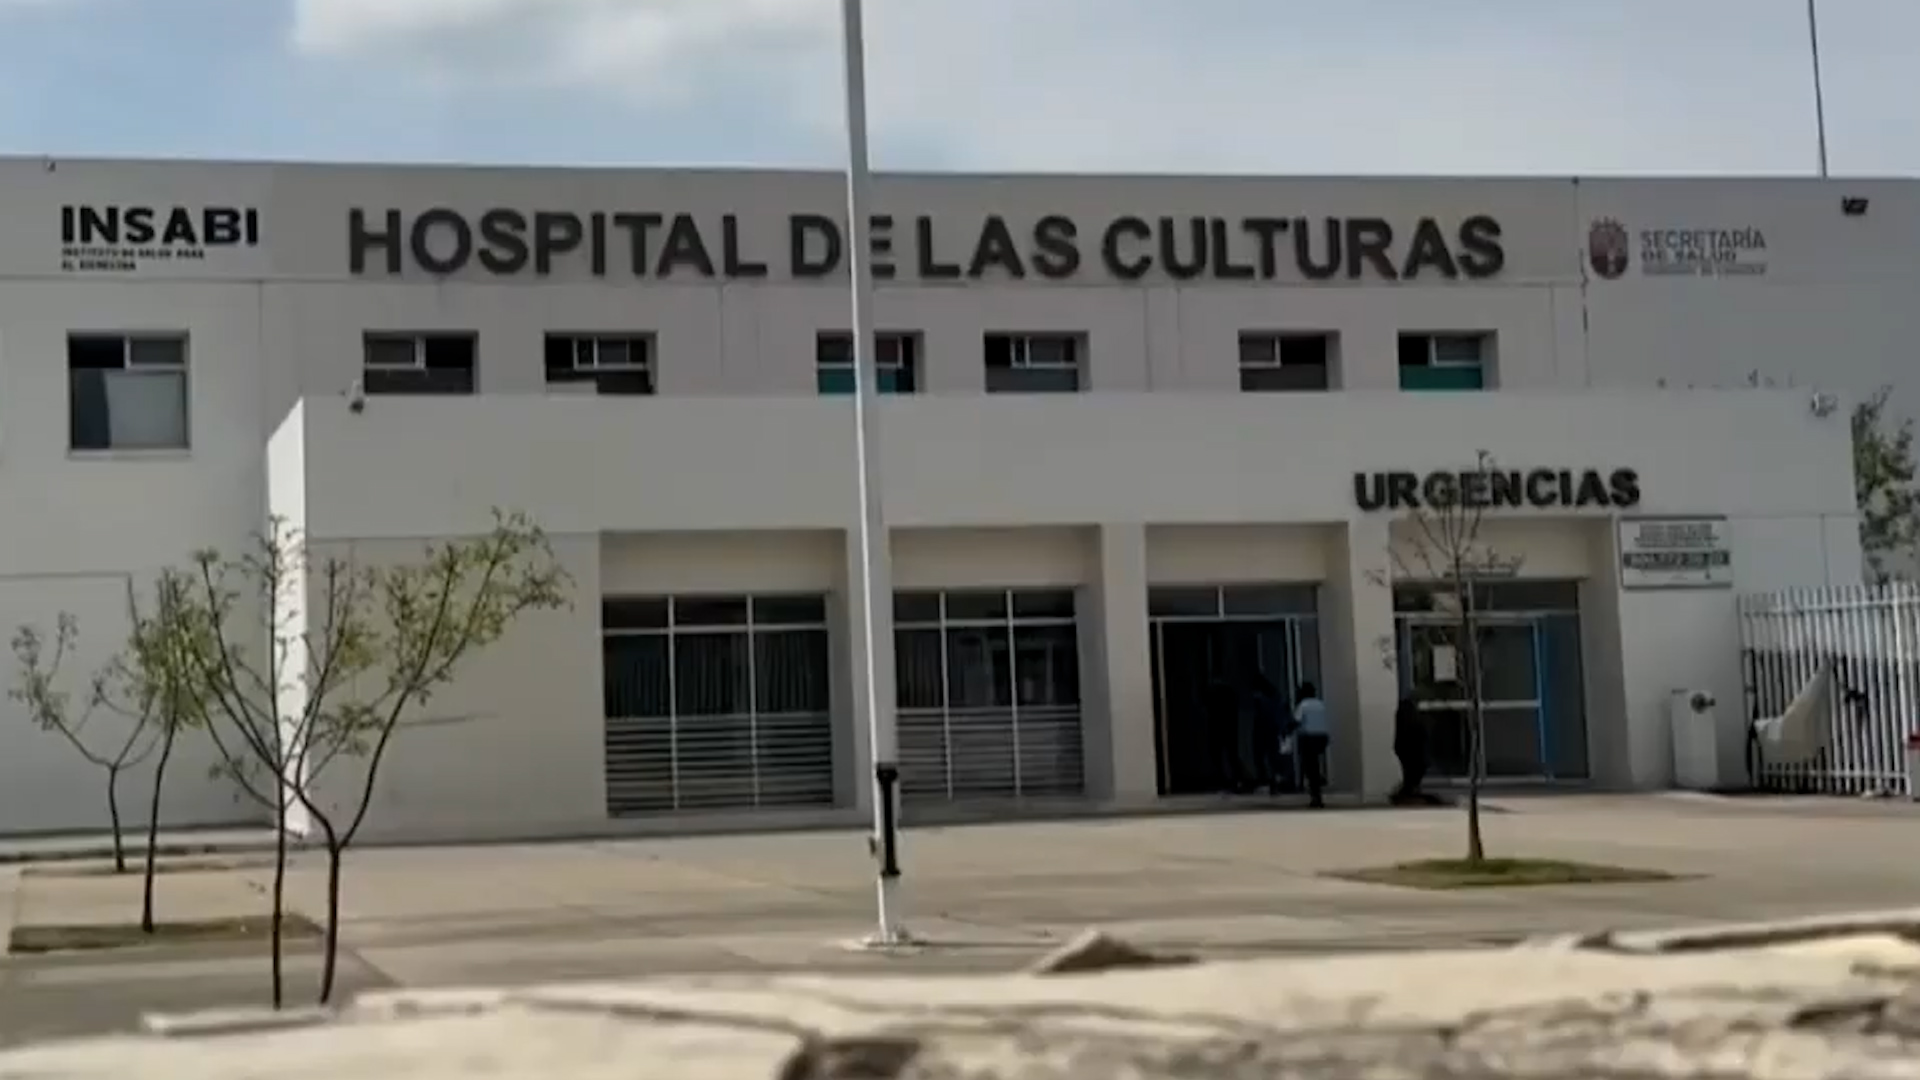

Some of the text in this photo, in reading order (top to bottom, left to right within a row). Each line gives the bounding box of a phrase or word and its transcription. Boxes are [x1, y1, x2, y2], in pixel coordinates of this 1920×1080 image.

[61, 205, 259, 246] INSABI
[348, 207, 1505, 280] HOSPITAL DE LAS CULTURAS
[1639, 226, 1766, 250] SECRETARÍA
[1354, 469, 1640, 511] URGENCIAS
